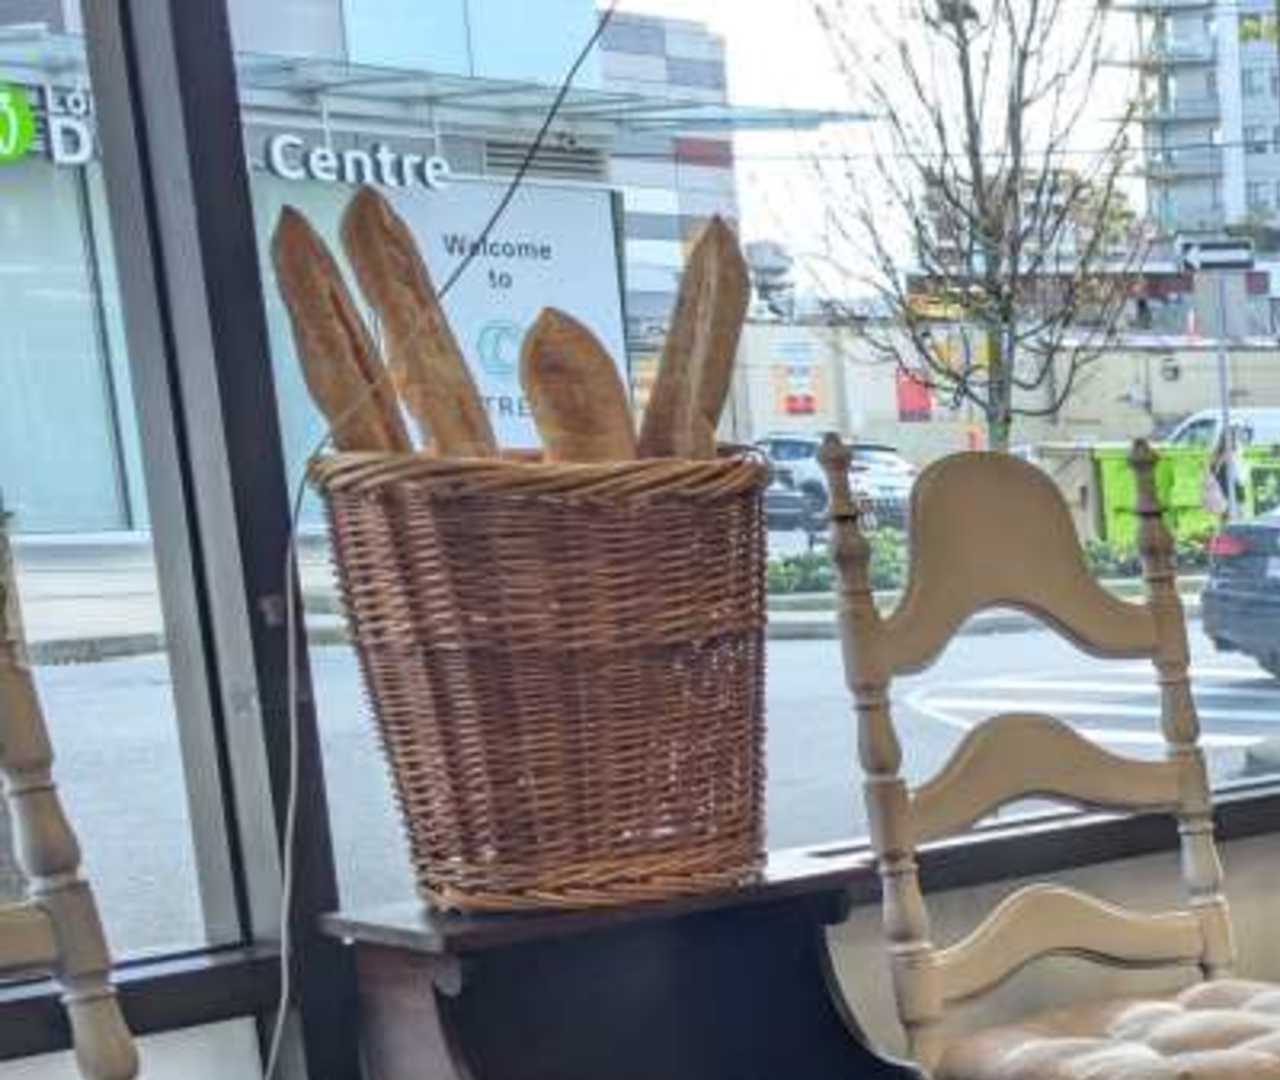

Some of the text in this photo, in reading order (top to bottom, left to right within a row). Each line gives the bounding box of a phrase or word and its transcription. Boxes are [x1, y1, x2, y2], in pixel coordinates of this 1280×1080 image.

[270, 133, 450, 188] Centre
[442, 233, 553, 260] Welcome
[488, 269, 512, 289] to
